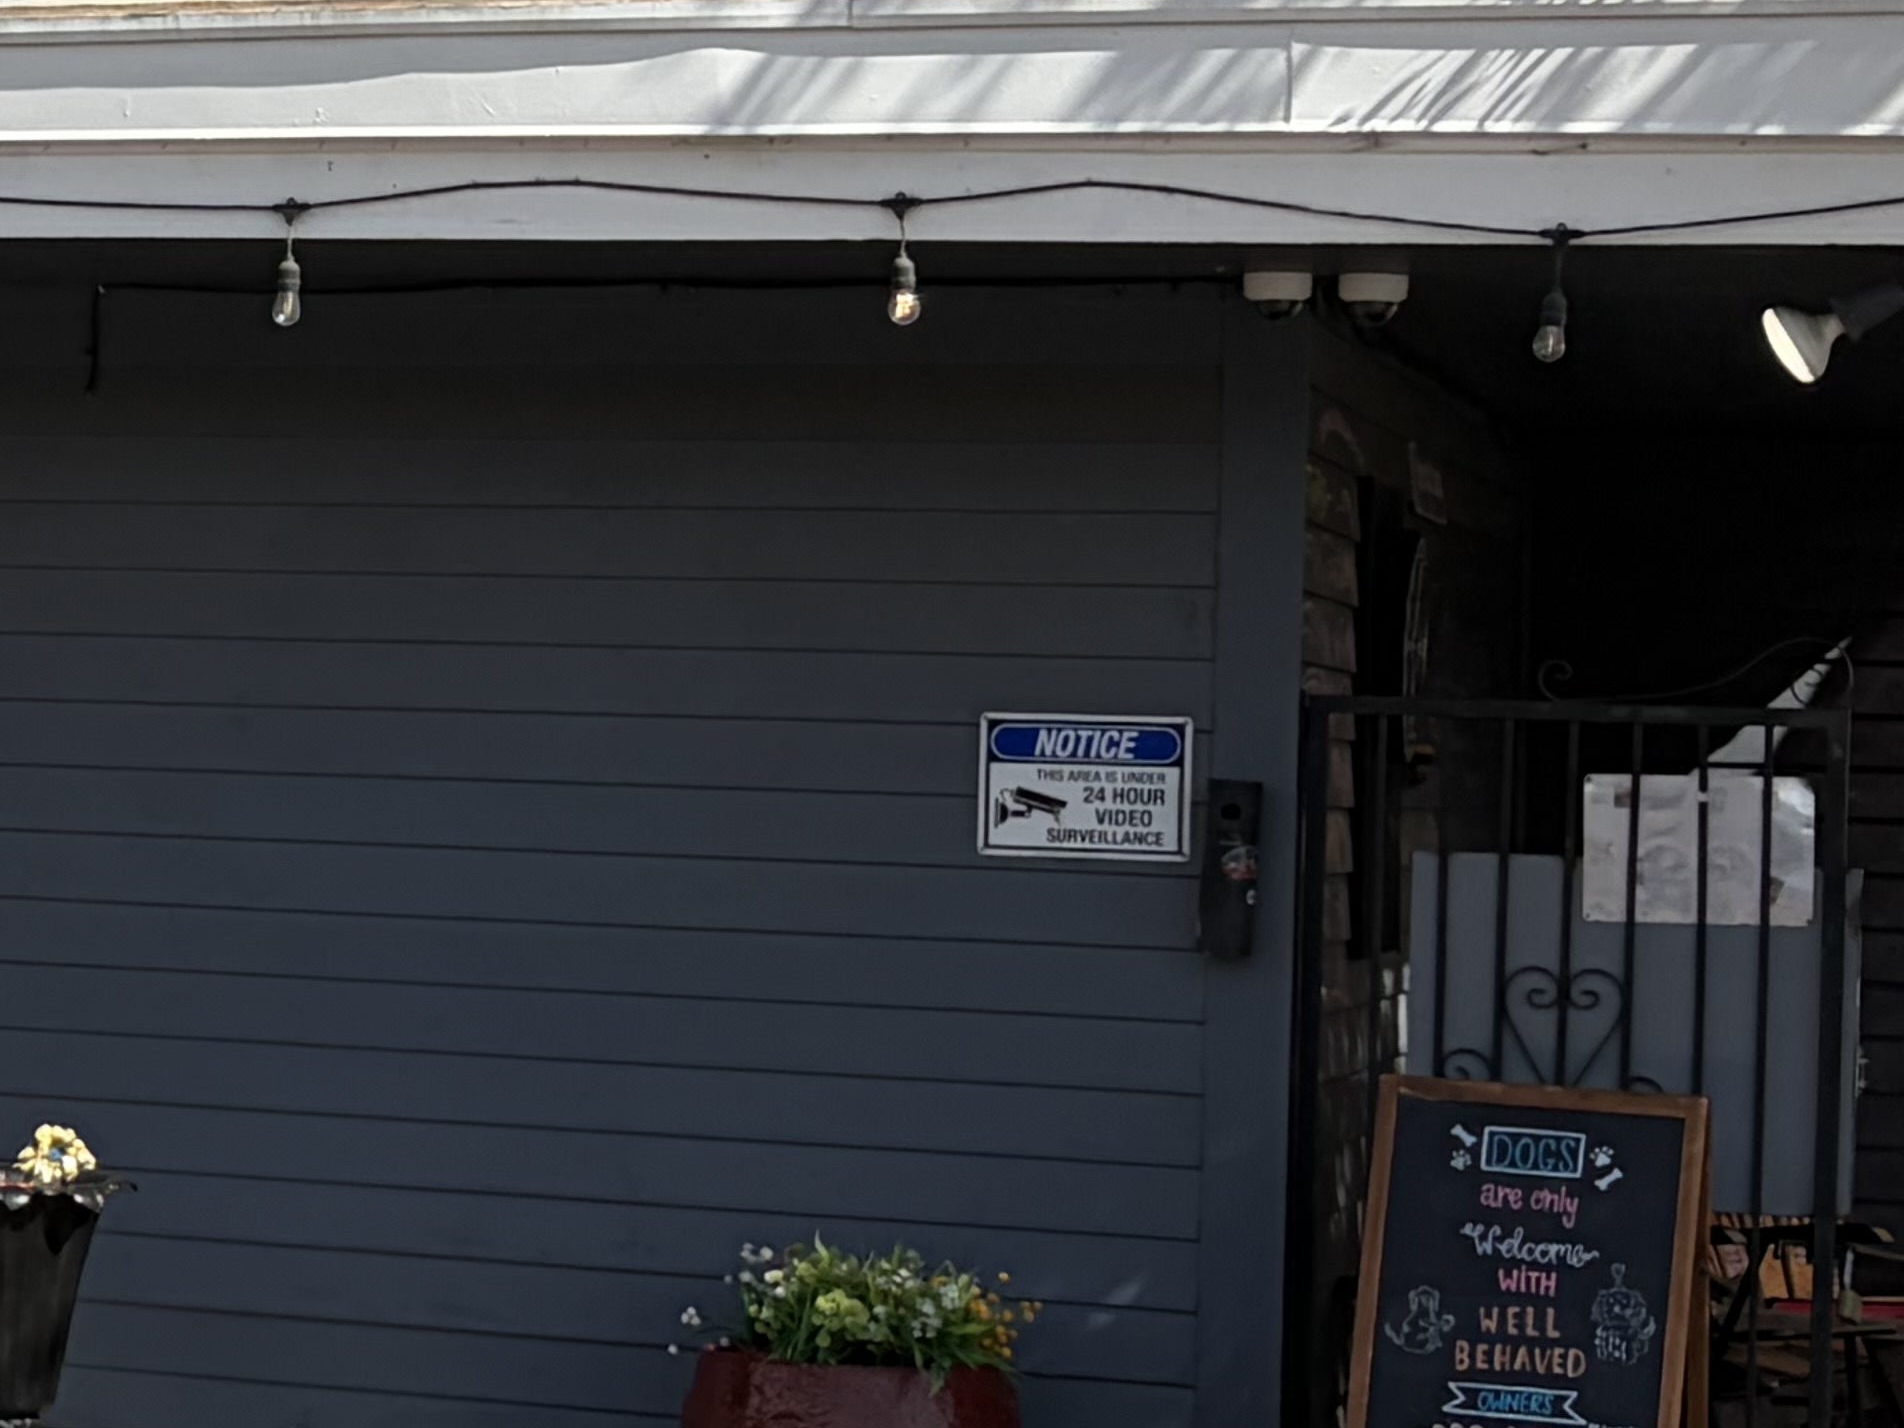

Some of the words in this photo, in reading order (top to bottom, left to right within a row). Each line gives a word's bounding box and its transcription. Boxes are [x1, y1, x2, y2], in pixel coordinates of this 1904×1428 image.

[1033, 728, 1139, 761] NOTICE
[1037, 769, 1064, 782] THIS
[1067, 770, 1100, 783] AREA
[1105, 771, 1118, 783] IS
[1122, 772, 1166, 784] UNDER
[1082, 786, 1107, 805] 24
[1112, 787, 1165, 805] HOUR
[1095, 808, 1153, 827] VIDEO
[1046, 828, 1165, 847] SURVEILLANCE
[1490, 1134, 1576, 1172] DOGS
[1480, 1183, 1524, 1211] are
[1530, 1185, 1580, 1230] only
[1459, 1221, 1600, 1269] Welcome
[1478, 1305, 1561, 1339] WELL
[1454, 1339, 1587, 1379] BEHAVED
[1476, 1390, 1556, 1416] OWNERS
